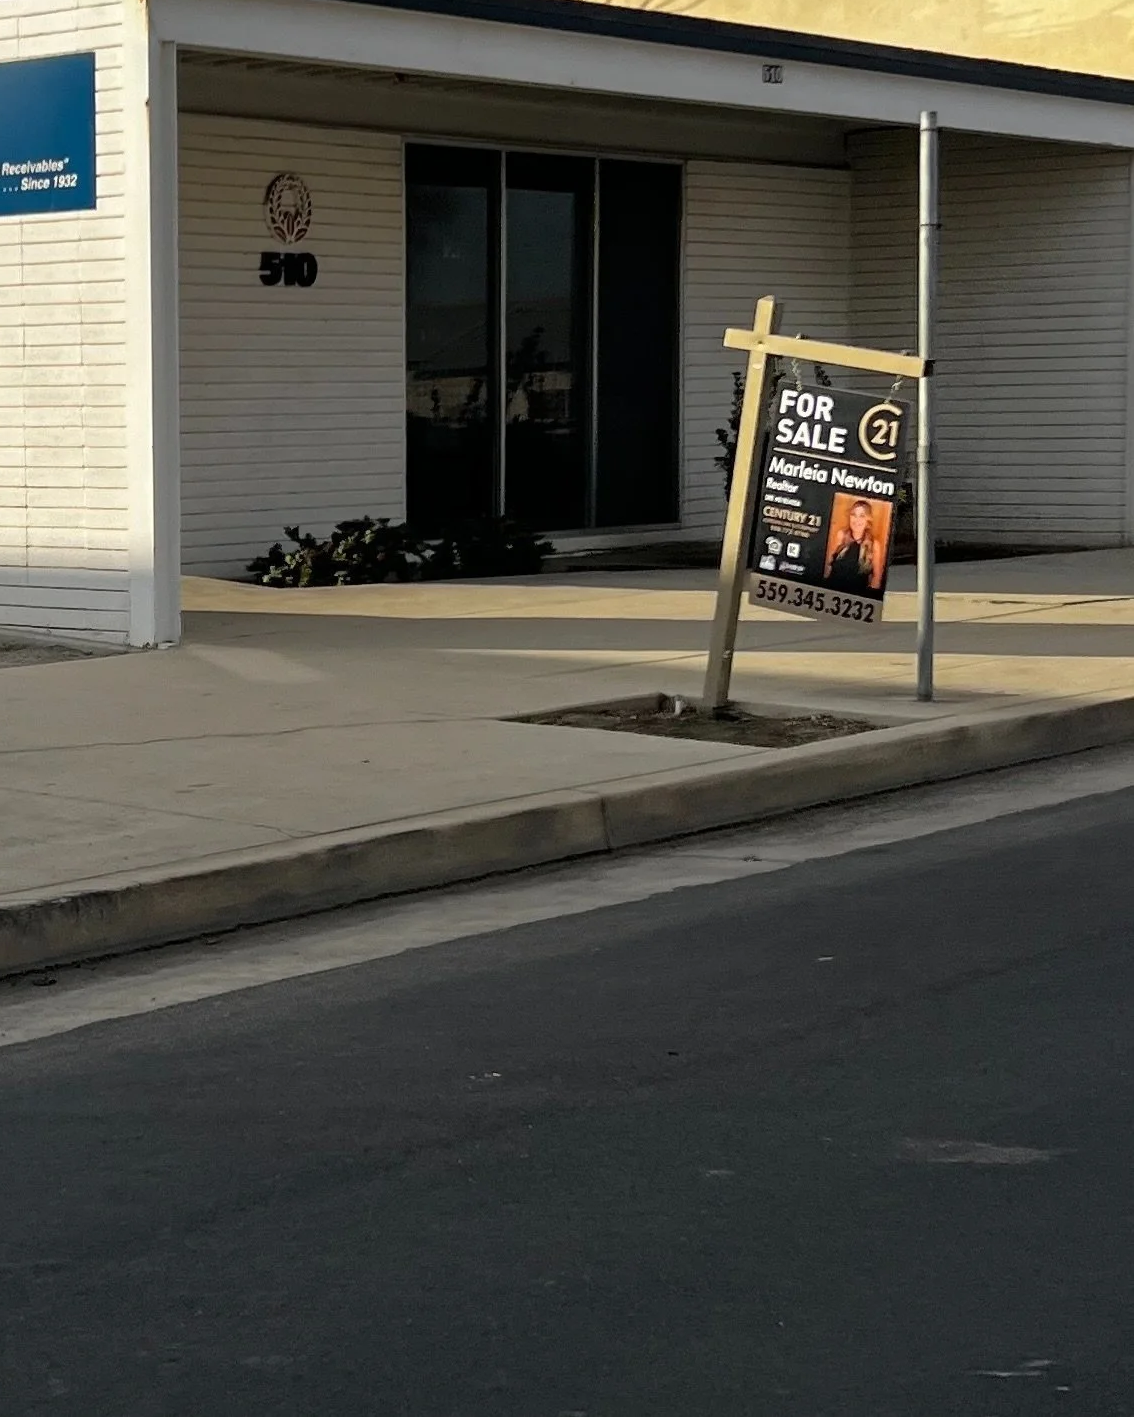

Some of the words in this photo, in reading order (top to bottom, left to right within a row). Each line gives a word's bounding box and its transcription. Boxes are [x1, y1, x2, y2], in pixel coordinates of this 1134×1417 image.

[53, 174, 78, 189] 1932
[258, 252, 318, 287] 510
[779, 389, 835, 422] FOR
[775, 418, 848, 454] SALE
[768, 456, 828, 484] Marleia
[831, 468, 895, 496] Newton
[763, 505, 808, 524] CENTURY
[807, 514, 822, 527] 21
[755, 579, 874, 623] 559.345.3232
